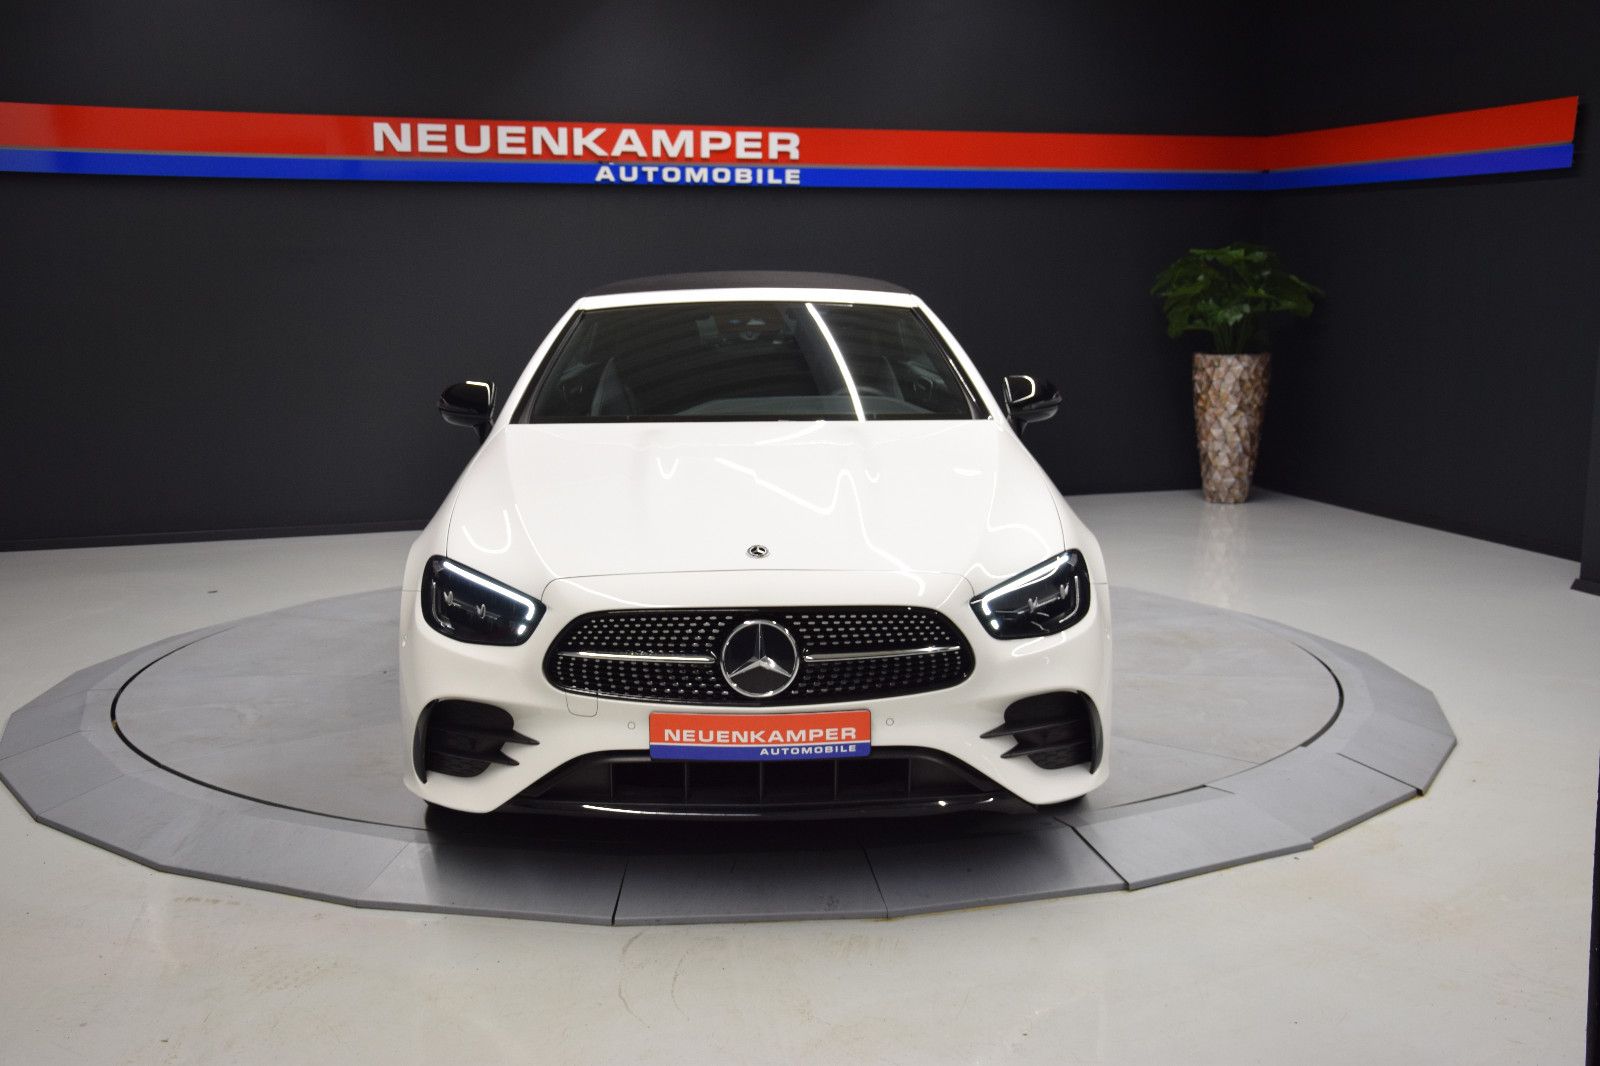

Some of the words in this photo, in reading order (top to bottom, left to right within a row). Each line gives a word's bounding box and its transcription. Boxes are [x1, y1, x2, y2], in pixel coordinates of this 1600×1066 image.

[372, 121, 801, 161] NEUENKAMPER
[594, 164, 801, 185] AUTOMOBILE
[664, 727, 857, 743] NEUENKAMPER
[759, 744, 857, 756] AUTOMOBILE
